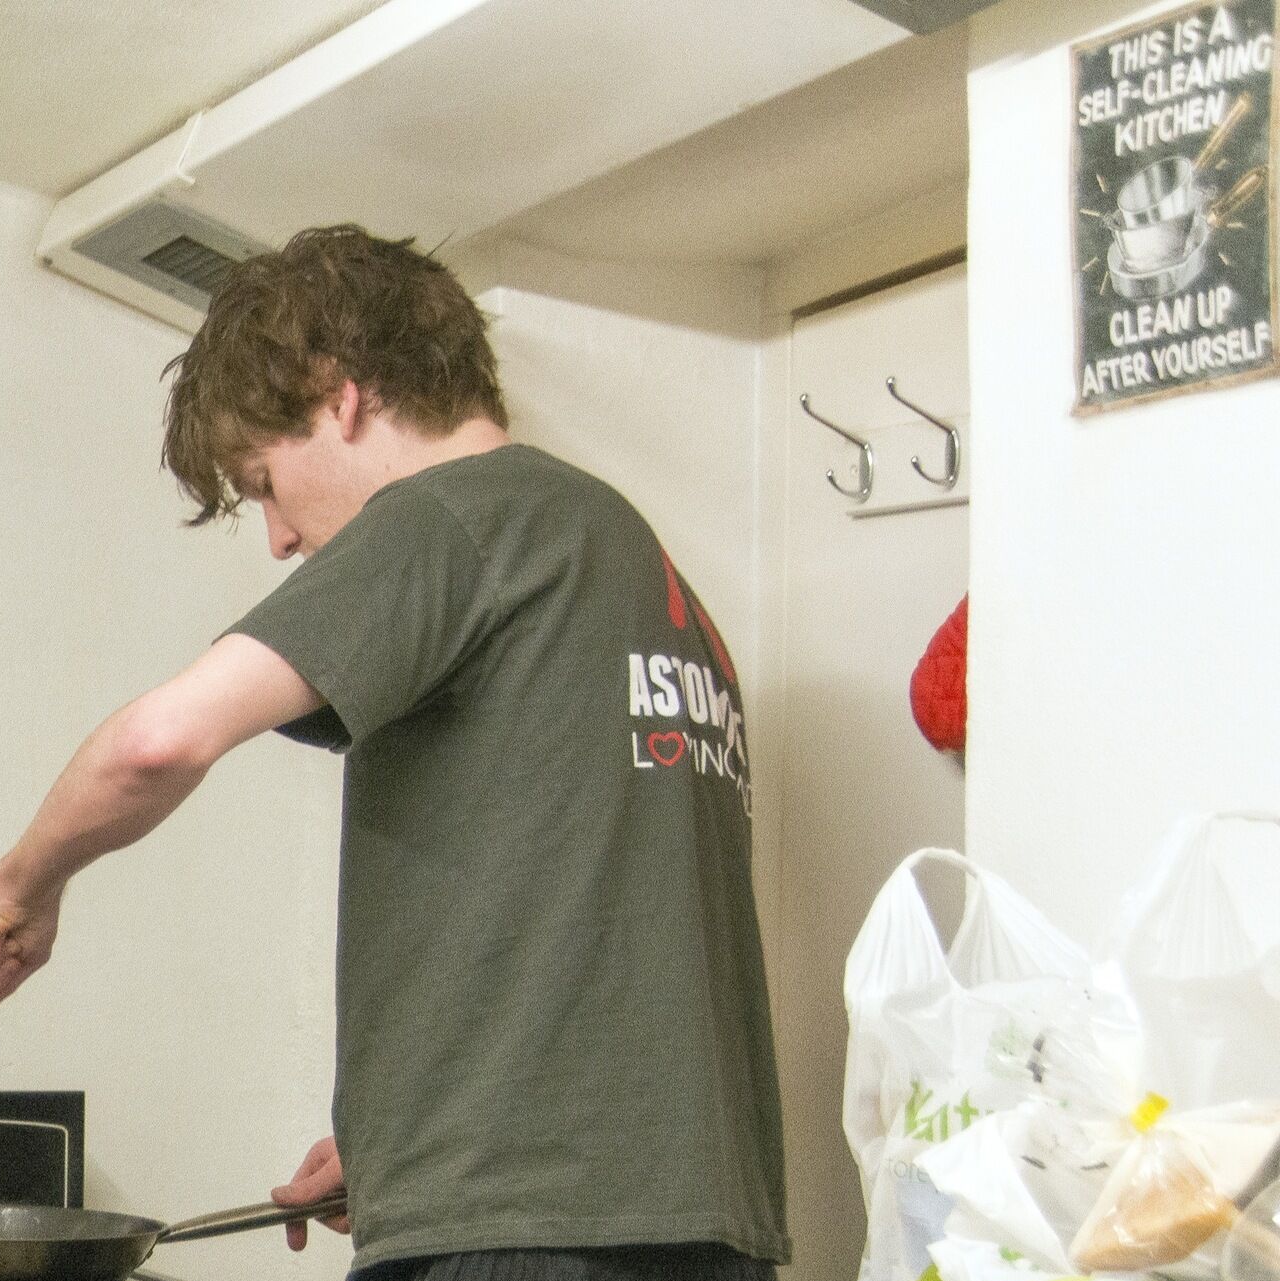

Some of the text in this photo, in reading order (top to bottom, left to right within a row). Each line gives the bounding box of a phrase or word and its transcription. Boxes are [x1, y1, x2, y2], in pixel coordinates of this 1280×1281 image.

[1109, 6, 1233, 79] THIS IS A
[1078, 34, 1272, 126] SELF-CLEANING
[1114, 92, 1225, 157] KITCHEN
[1109, 285, 1232, 347] CLEAN UP
[1081, 321, 1271, 398] AFTER YOURSELF
